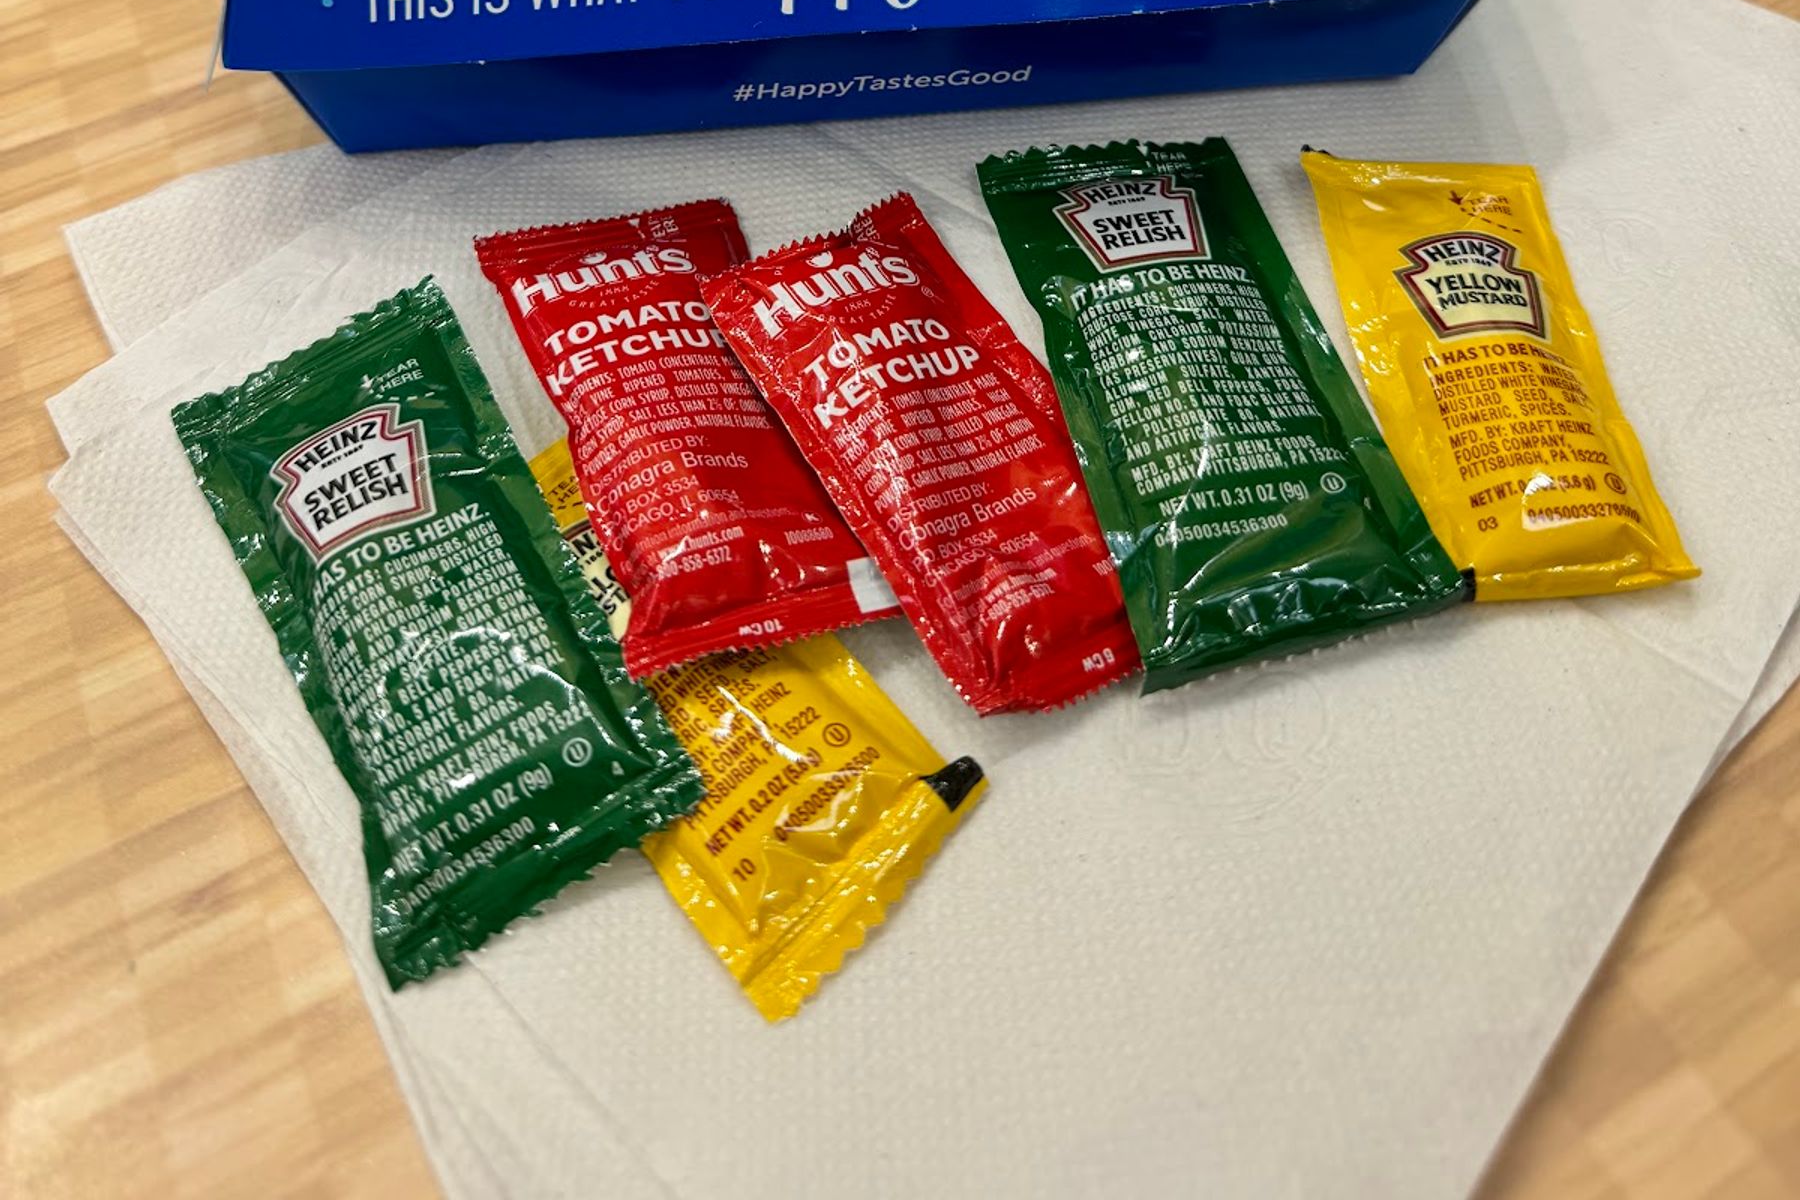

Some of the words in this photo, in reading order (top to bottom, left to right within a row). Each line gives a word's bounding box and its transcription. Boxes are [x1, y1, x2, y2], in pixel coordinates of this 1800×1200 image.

[732, 65, 1033, 104] #HappyTastesGood
[1083, 182, 1157, 204] HEINZ
[1093, 209, 1175, 234] SWEET
[1101, 225, 1187, 250] RELISH
[1422, 240, 1501, 263] HEINZ
[1135, 270, 1166, 288] TO
[1167, 264, 1193, 279] BE
[1198, 263, 1256, 285] HEINZ.
[1425, 273, 1522, 295] YELLOW
[1078, 290, 1165, 327] INGREDIENTS:
[1167, 282, 1236, 299] CUCUMBERS,
[1082, 310, 1134, 340] FRUCTOSE
[1138, 304, 1170, 321] CORN
[1215, 293, 1268, 311] DISTILLED
[1438, 291, 1528, 310] MUSTARD
[543, 301, 711, 356] TOMATO
[1087, 326, 1121, 352] WHITE
[1127, 315, 1186, 333] VINEGAR,
[1194, 307, 1227, 321] SALT,
[1091, 334, 1142, 363] CALCIUM
[1149, 322, 1213, 341] CHLORIDE,
[1218, 321, 1281, 339] POTASSIUM
[1152, 338, 1176, 352] AND
[1182, 334, 1227, 349] SODIUM
[617, 357, 657, 379] TOMATO
[804, 318, 950, 392] TOMATO
[1230, 351, 1259, 365] GUAR
[1442, 347, 1478, 366] HAS
[1479, 344, 1506, 358] TO
[1507, 342, 1530, 356] BE
[379, 369, 424, 392] HERE
[623, 372, 666, 394] RIPENED
[813, 345, 980, 430] KETCHUP
[1181, 364, 1236, 380] SULFATE,
[1430, 361, 1534, 388] INGREDIENTS:
[1434, 377, 1496, 402] DISTILLED
[1500, 374, 1538, 389] WHITE
[674, 381, 719, 398] DISTILLED
[1109, 395, 1142, 417] GUM,
[1147, 384, 1171, 401] RED
[1179, 379, 1209, 394] BELL
[1213, 378, 1269, 394] PEPPERS,
[1438, 391, 1501, 417] MUSTARD
[1513, 388, 1552, 404] SEED,
[1115, 404, 1162, 432] YELLOW
[1165, 398, 1189, 414] NO.
[1201, 392, 1225, 408] AND
[1228, 391, 1260, 406] FD&C
[1262, 391, 1290, 406] BLUE
[1142, 409, 1228, 438] POLYSORBATE
[1443, 405, 1517, 430] TURMERIC,
[1520, 401, 1572, 417] SPICES.
[294, 420, 378, 473] HEINZ
[1125, 443, 1151, 463] AND
[1227, 419, 1288, 436] FLAVORS.
[1449, 429, 1482, 450] MFD.
[1486, 425, 1508, 439] BY:
[1510, 419, 1553, 436] KRAFT
[1556, 419, 1596, 436] HEINZ
[1453, 441, 1498, 464] FOODS
[1501, 435, 1572, 452] COMPANY,
[589, 436, 683, 497] DISTRIBUTED
[687, 434, 711, 448] BY:
[1130, 463, 1165, 485] MFD.
[1166, 453, 1190, 471] BY:
[1236, 438, 1273, 455] HEINZ
[1274, 434, 1317, 450] FOODS
[1291, 450, 1309, 466] PA
[1458, 451, 1549, 481] PITTSBURGH,
[1550, 448, 1570, 463] PA
[1571, 448, 1610, 465] 15222
[304, 452, 398, 514] SWEET
[596, 459, 675, 517] Conagra
[681, 451, 749, 469] Brands
[625, 490, 662, 514] BOX
[664, 474, 700, 497] 3534
[1158, 492, 1190, 518] NET
[1190, 491, 1221, 511] WT.
[1222, 486, 1253, 508] 0.31
[1255, 483, 1277, 502] OZ
[1279, 479, 1310, 502] (9g)
[1469, 485, 1496, 509] NET
[1493, 481, 1519, 500] WT.
[312, 472, 409, 532] RELISH
[972, 485, 1037, 523] Brands
[347, 541, 381, 569] TO
[384, 530, 416, 556] BE
[415, 502, 491, 548] HEINZ.
[1477, 516, 1498, 532] 03
[384, 534, 467, 575] CUCUMBERS,
[465, 520, 497, 549] HIGH
[352, 583, 387, 611] CORN
[440, 533, 504, 572] DISTILLED
[413, 574, 451, 599] SALT,
[461, 549, 512, 575] WATER,
[363, 601, 435, 642] CHLORIDE,
[441, 561, 519, 602] POTASSIUM
[458, 573, 526, 613] BENZOATE
[456, 603, 494, 631] GUAR
[751, 682, 792, 714] HEINZ
[508, 701, 556, 738] FOODS
[779, 706, 822, 741] 15222
[454, 798, 494, 833] 0.31
[493, 782, 520, 810] OZ
[705, 826, 731, 858] NET
[732, 857, 756, 882] 10
